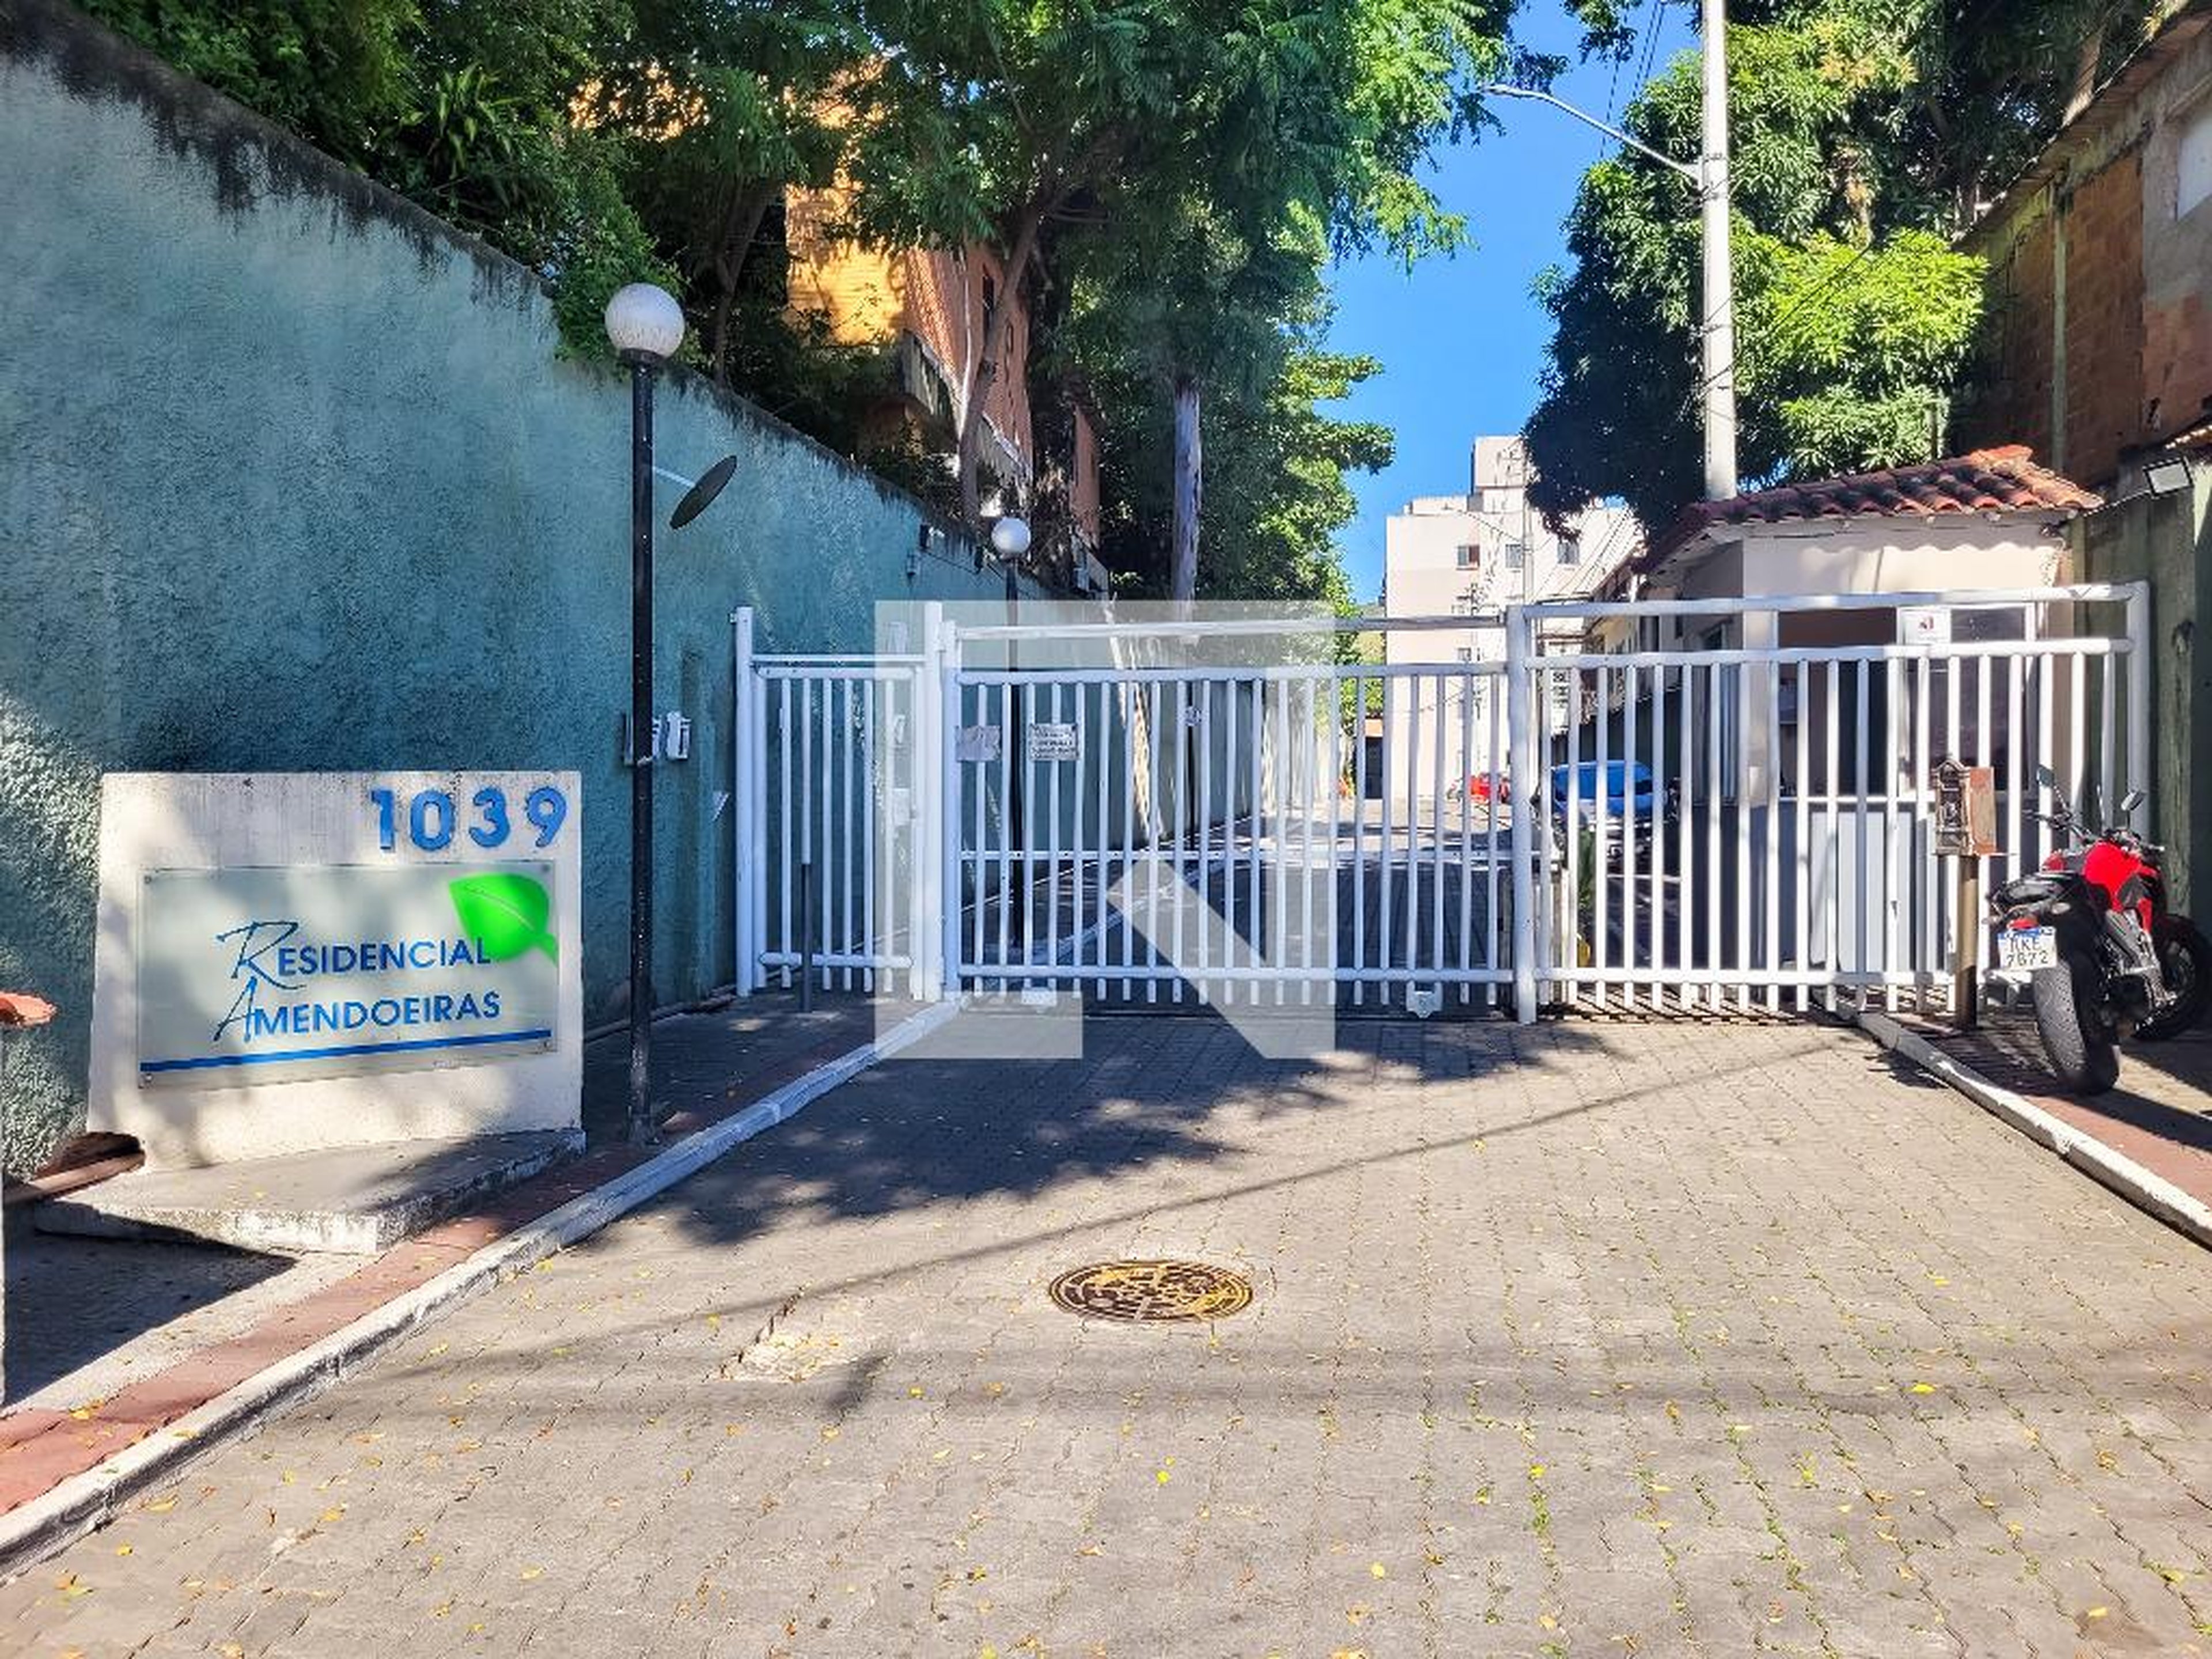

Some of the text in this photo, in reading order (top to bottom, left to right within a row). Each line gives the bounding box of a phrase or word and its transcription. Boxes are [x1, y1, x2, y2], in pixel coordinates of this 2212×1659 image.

[370, 786, 567, 851] 1039
[215, 921, 491, 990] RESIDENCIAL
[213, 976, 500, 1042] AMENDOEIRAS
